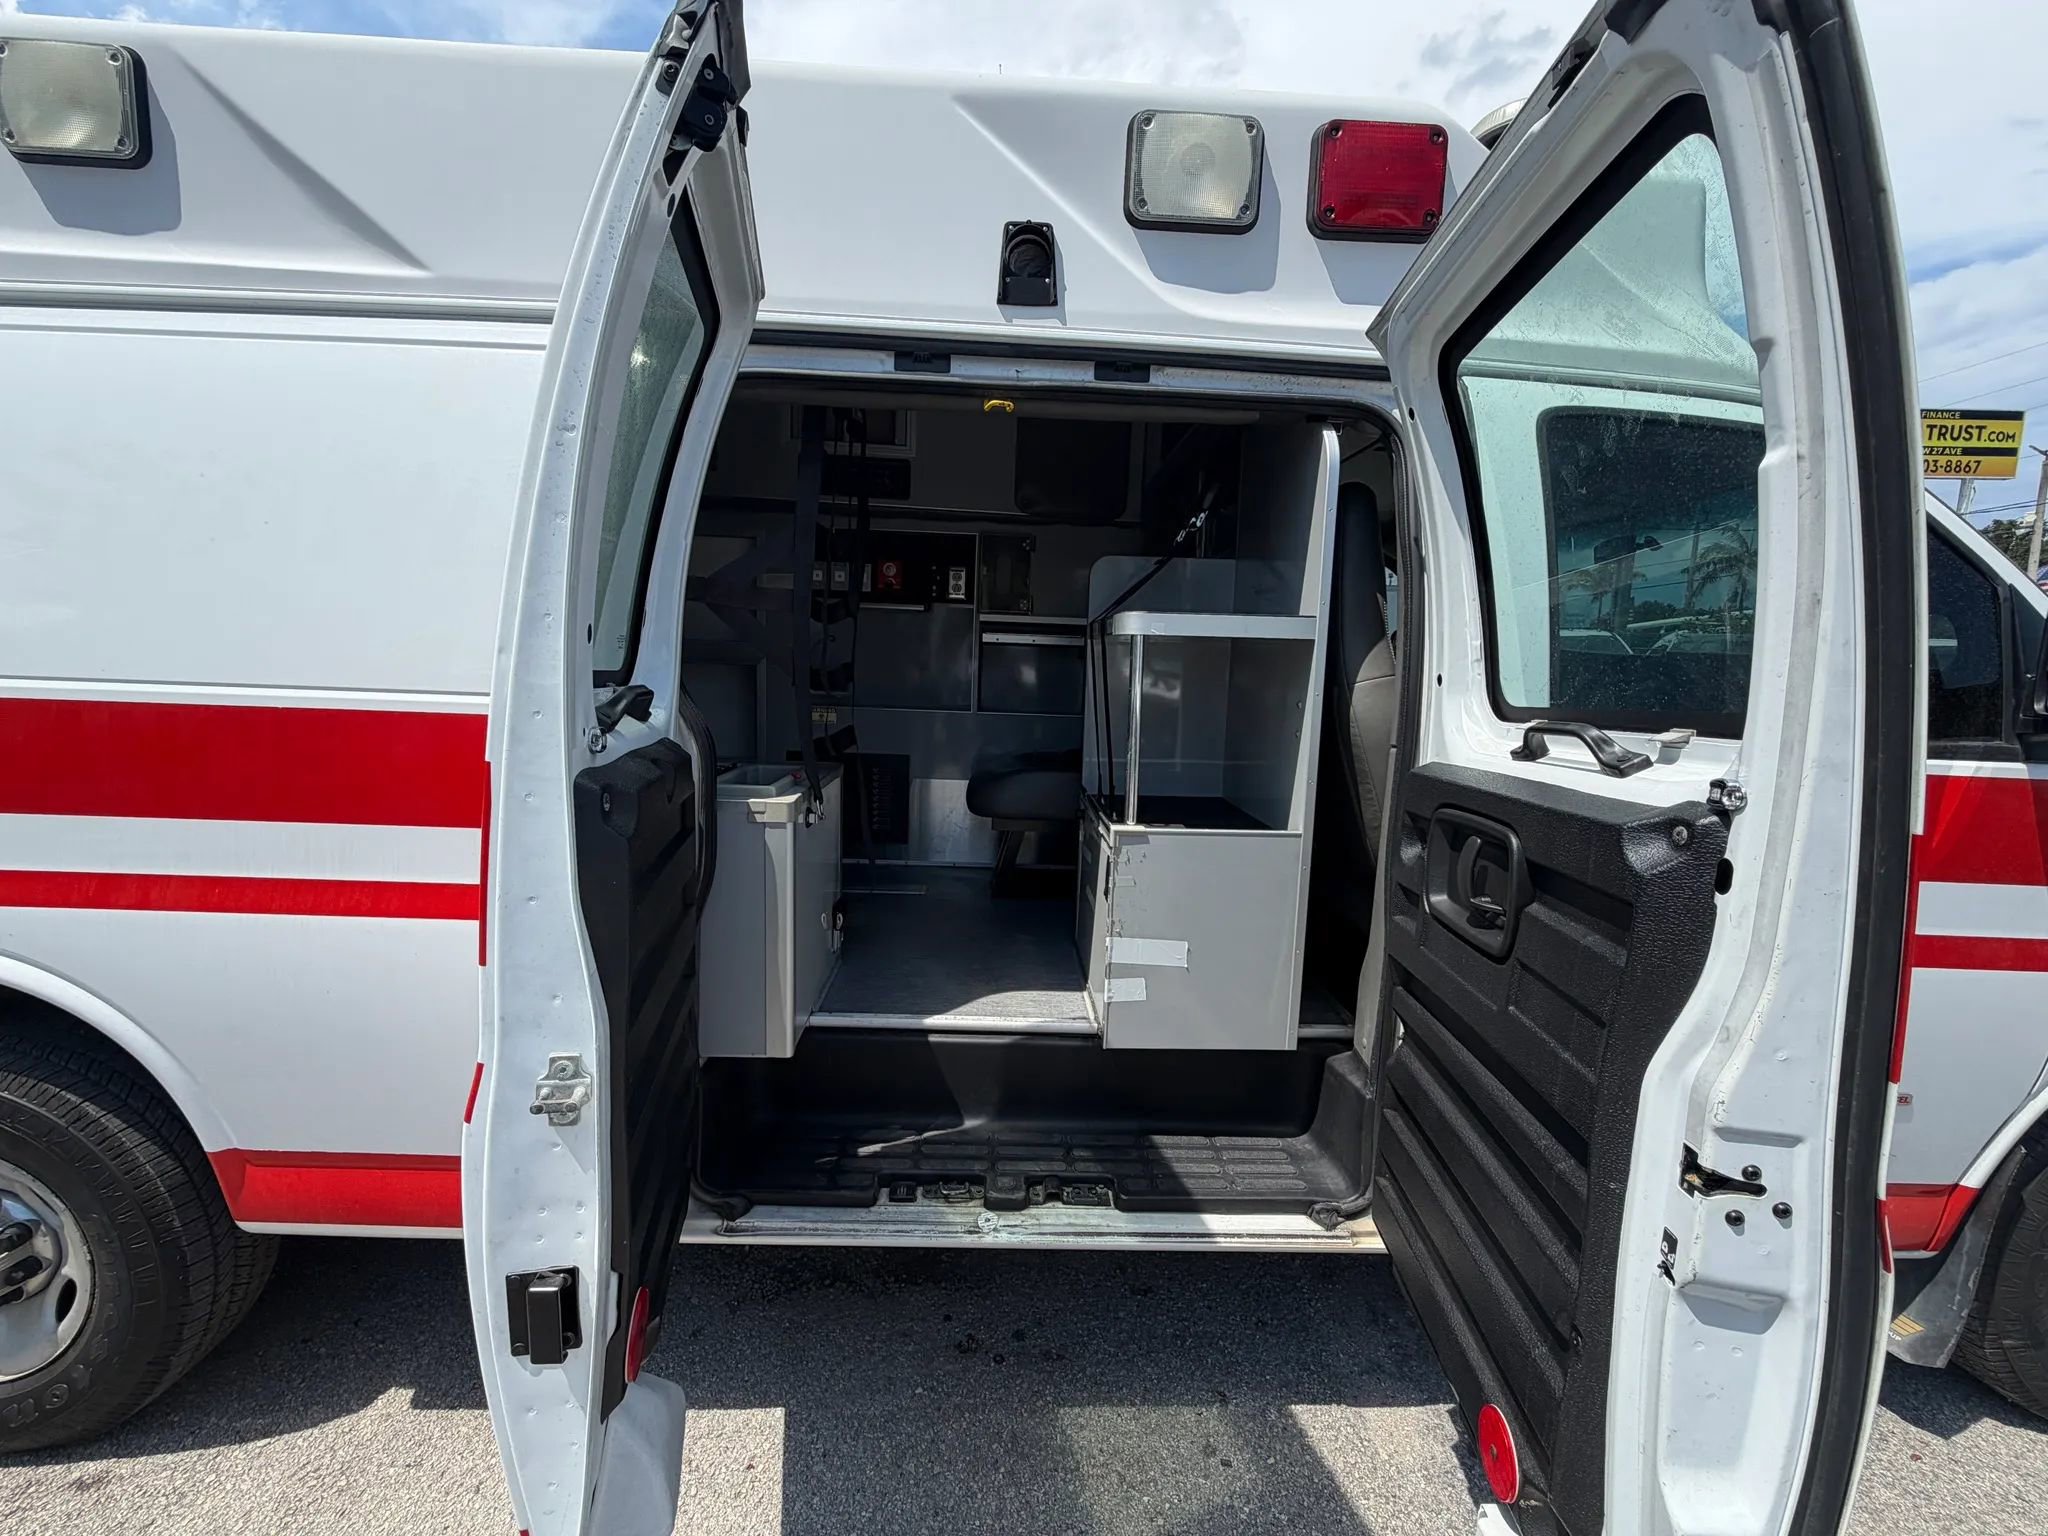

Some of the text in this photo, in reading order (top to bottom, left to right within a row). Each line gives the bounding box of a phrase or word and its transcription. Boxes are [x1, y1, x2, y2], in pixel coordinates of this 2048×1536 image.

[1921, 411, 1961, 419] FINANCE
[1926, 424, 2016, 443] TRUST.COM
[1944, 448, 1963, 456] AVE
